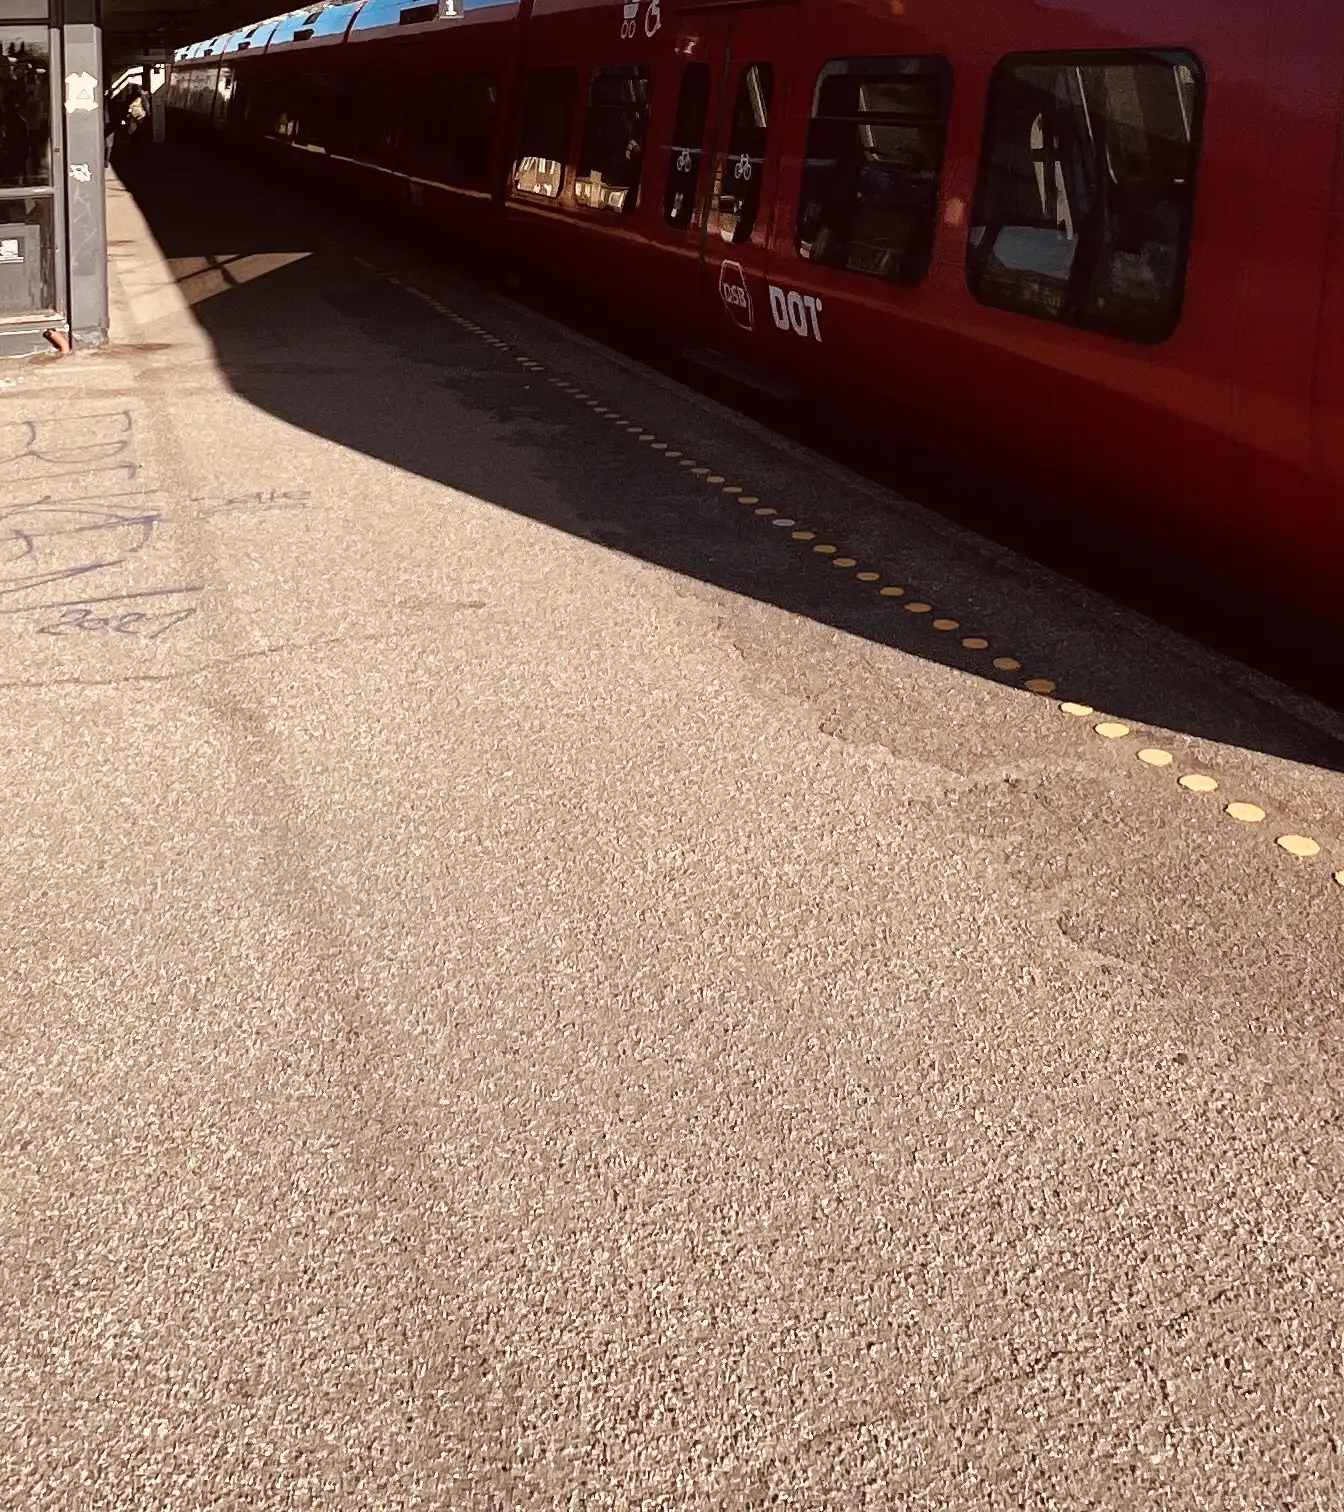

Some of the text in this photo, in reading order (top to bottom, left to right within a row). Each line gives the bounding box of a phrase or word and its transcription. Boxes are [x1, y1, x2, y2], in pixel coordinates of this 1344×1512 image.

[445, 0, 457, 16] 1
[722, 282, 747, 308] DSB
[768, 285, 823, 343] DOT
